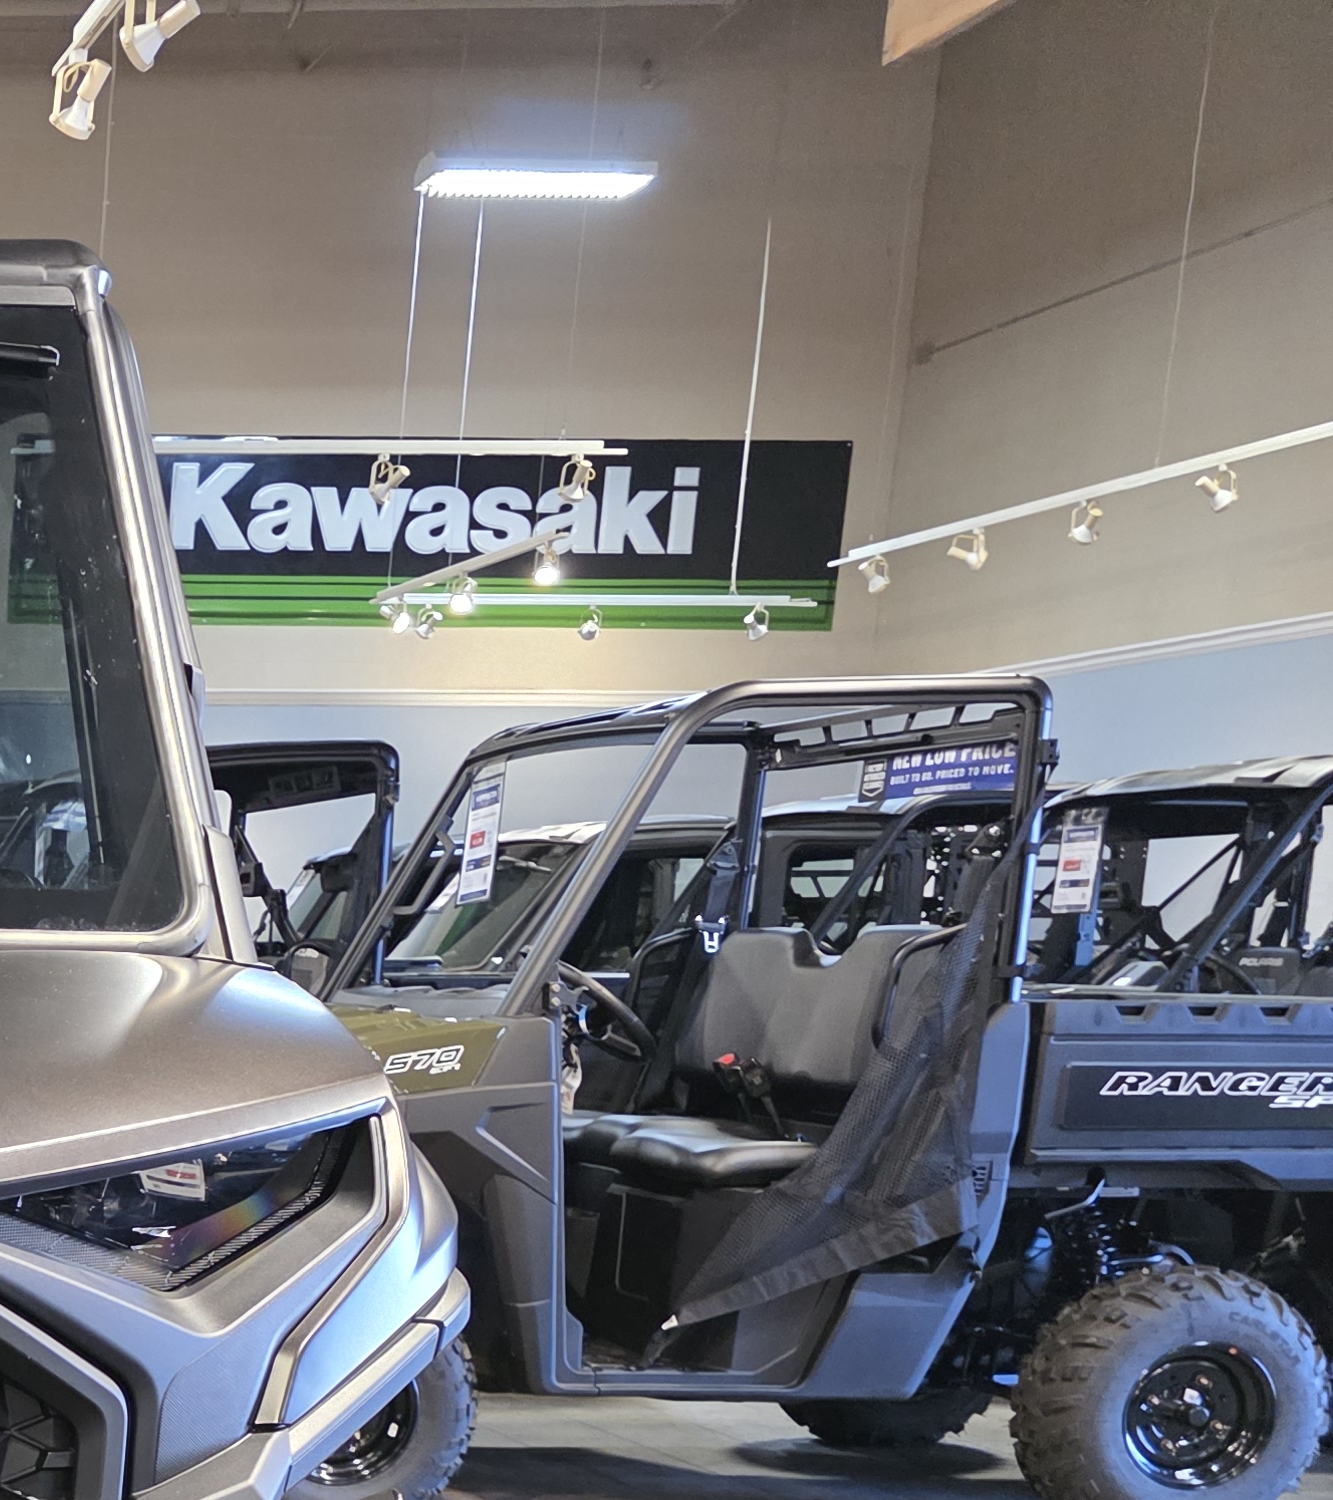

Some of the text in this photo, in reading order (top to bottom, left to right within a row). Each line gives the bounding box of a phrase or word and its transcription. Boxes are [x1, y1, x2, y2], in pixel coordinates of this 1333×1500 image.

[169, 461, 700, 555] Kawasaki
[968, 766, 980, 777] TO
[383, 1045, 465, 1074] 570
[1099, 1071, 1333, 1096] RANGER
